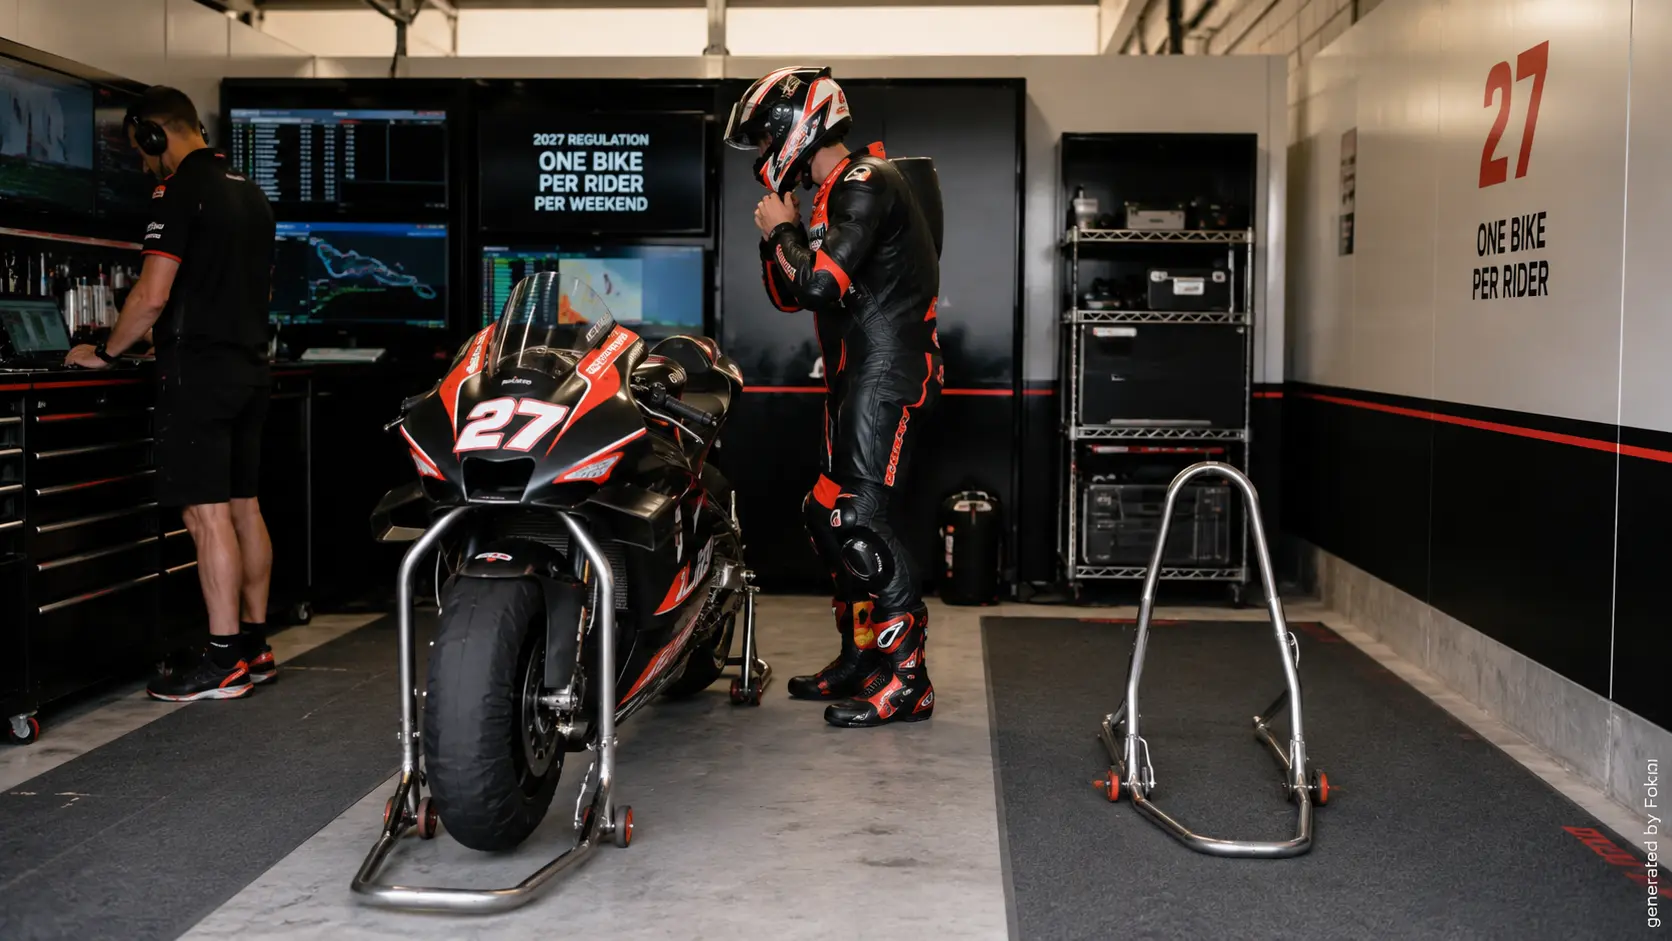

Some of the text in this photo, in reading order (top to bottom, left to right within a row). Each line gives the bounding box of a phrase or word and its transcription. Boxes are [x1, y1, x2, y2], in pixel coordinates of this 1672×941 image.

[1479, 40, 1549, 188] 27
[533, 133, 649, 146] 2027 REGULATION
[539, 151, 643, 171] ONE BIKE
[539, 174, 644, 192] PER RIDER
[534, 196, 648, 211] PER WEEKEND
[1477, 211, 1547, 257] ONE BIKE
[1472, 260, 1549, 300] PER RIDER
[453, 396, 570, 453] 27
